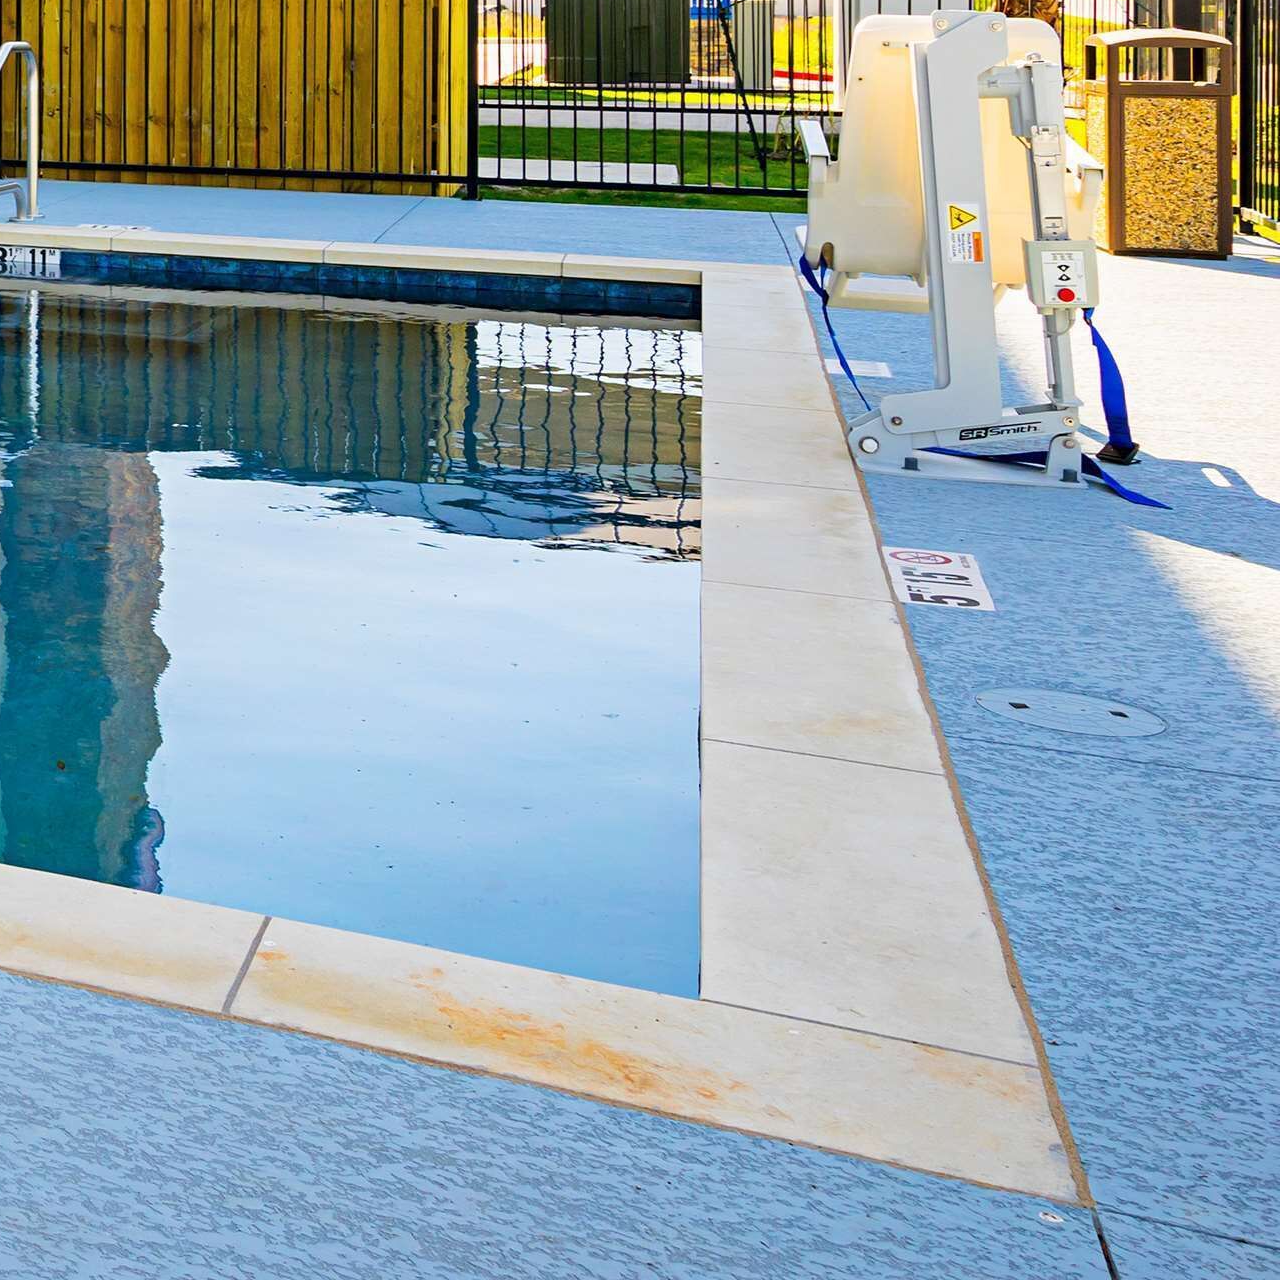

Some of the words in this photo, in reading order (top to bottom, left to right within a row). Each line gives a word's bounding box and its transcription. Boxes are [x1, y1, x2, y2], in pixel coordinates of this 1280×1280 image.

[960, 429, 988, 440] SR
[989, 425, 1038, 436] Smith
[908, 592, 981, 607] 5
